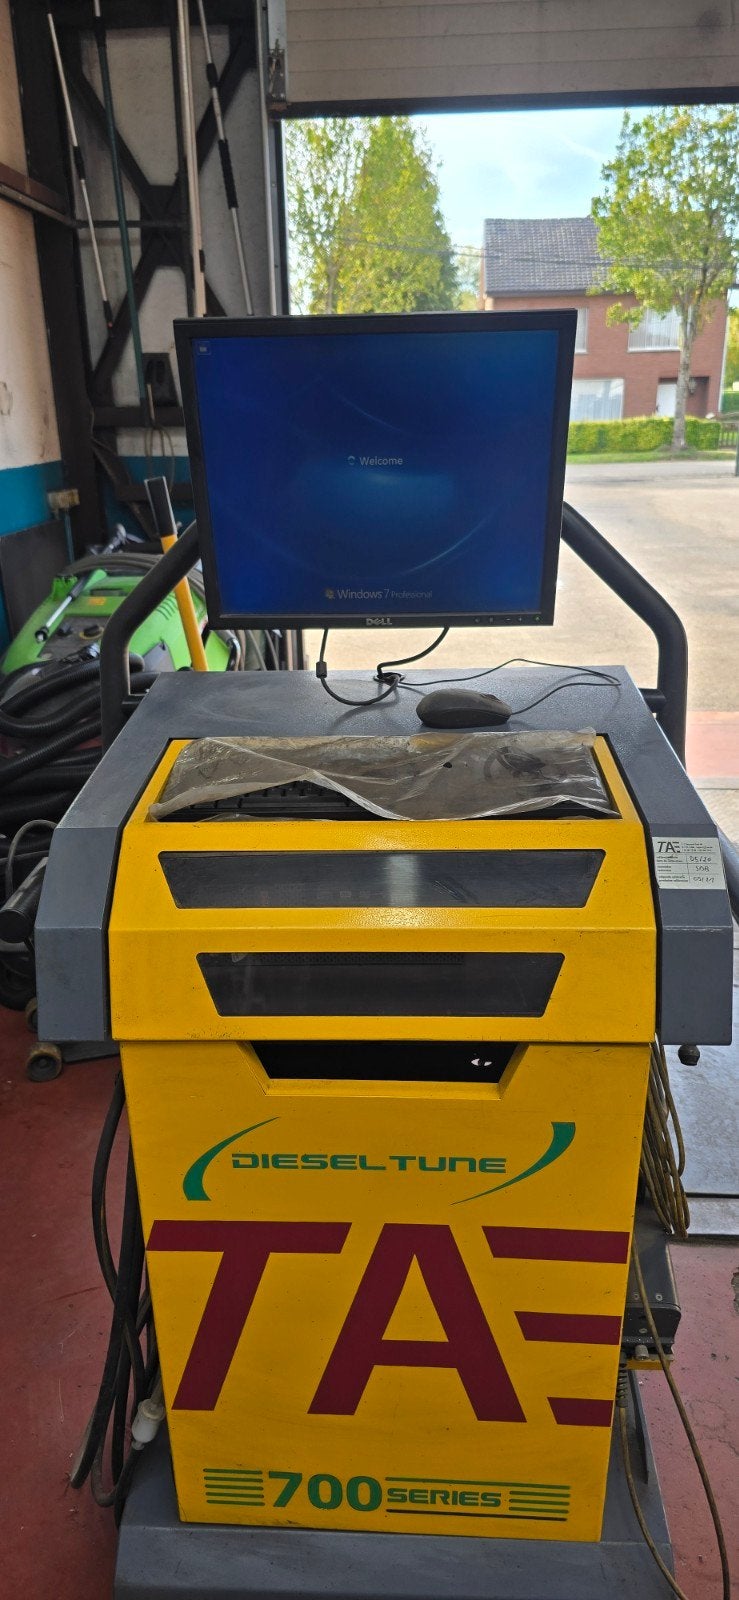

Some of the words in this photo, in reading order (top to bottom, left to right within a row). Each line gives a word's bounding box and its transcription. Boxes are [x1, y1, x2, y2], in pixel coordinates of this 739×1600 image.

[359, 455, 403, 466] Welcome
[336, 589, 383, 599] Windows
[384, 588, 390, 599] 7
[391, 590, 433, 600] Professional
[365, 618, 393, 626] DELL
[268, 1471, 383, 1512] 700
[387, 1487, 502, 1508] SERIES
